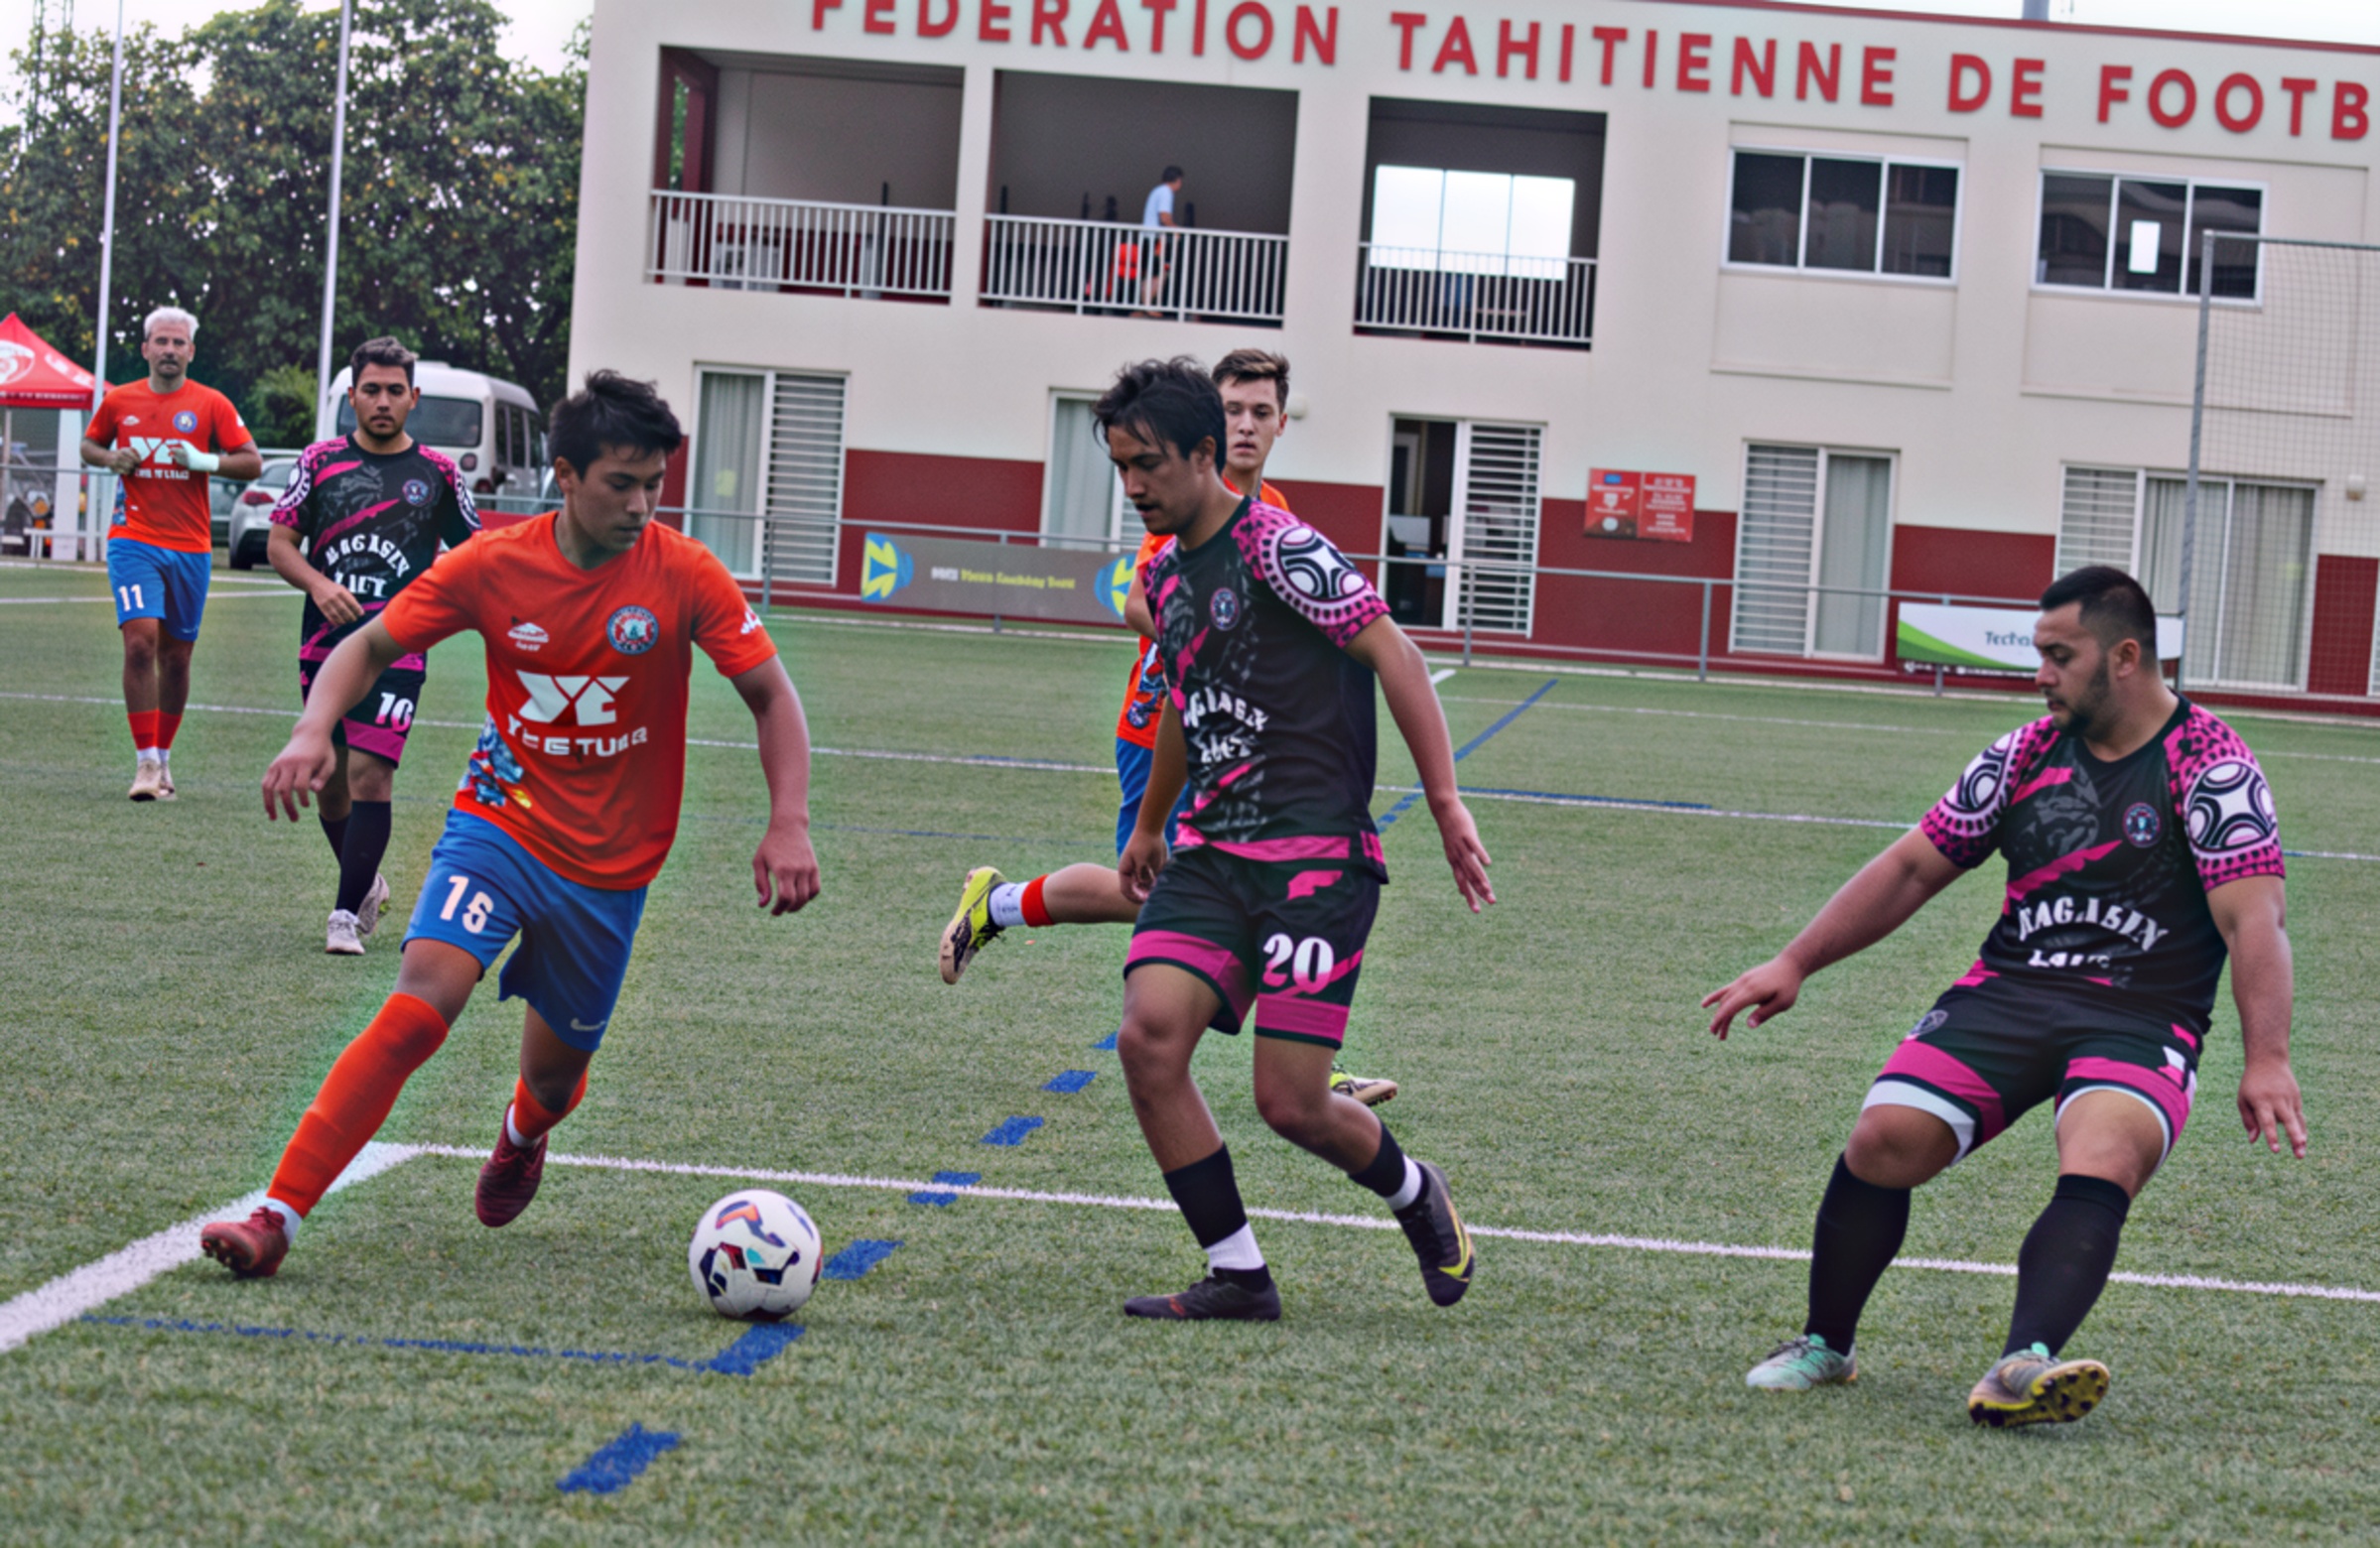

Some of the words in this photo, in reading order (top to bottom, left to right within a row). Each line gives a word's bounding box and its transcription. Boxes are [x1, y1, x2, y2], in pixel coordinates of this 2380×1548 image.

[1389, 11, 1898, 107] TAHITIENNE
[1947, 53, 2047, 119] DE
[2097, 64, 2371, 141] FOOTB
[118, 584, 145, 611] 11
[375, 692, 414, 732] 10
[440, 875, 494, 934] 16
[1262, 932, 1335, 994] 20
